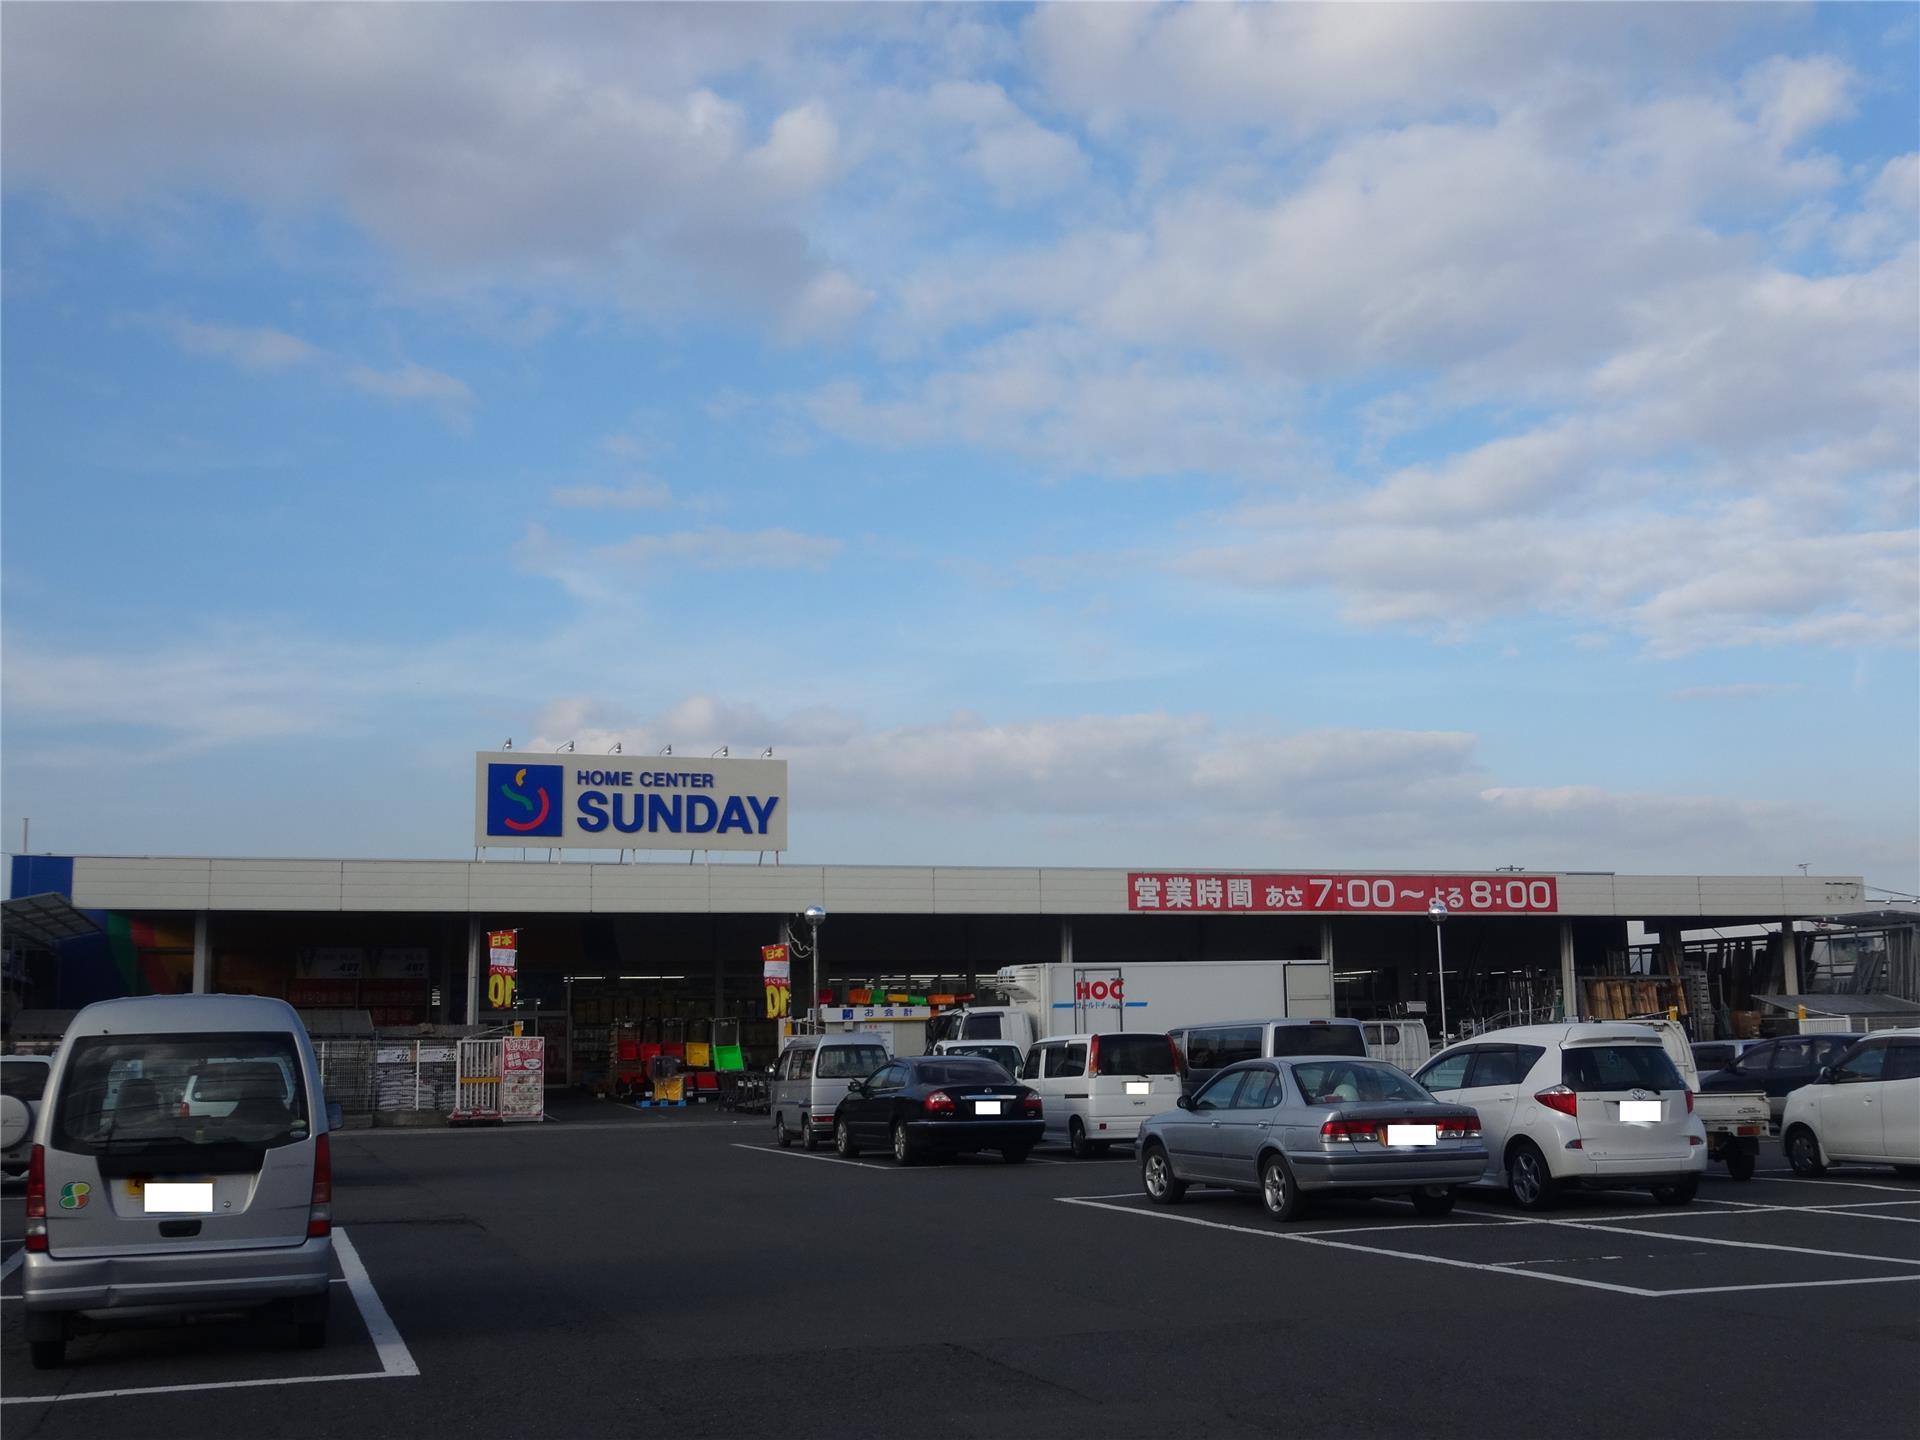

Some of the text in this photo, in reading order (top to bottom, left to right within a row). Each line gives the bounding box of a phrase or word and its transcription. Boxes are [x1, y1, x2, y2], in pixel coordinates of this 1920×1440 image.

[577, 769, 714, 787] HOME CENTER
[577, 790, 779, 834] SUNDAY
[1134, 877, 1253, 910] 営業時間
[1077, 980, 1124, 1003] HOC
[864, 1008, 913, 1018] お会計
